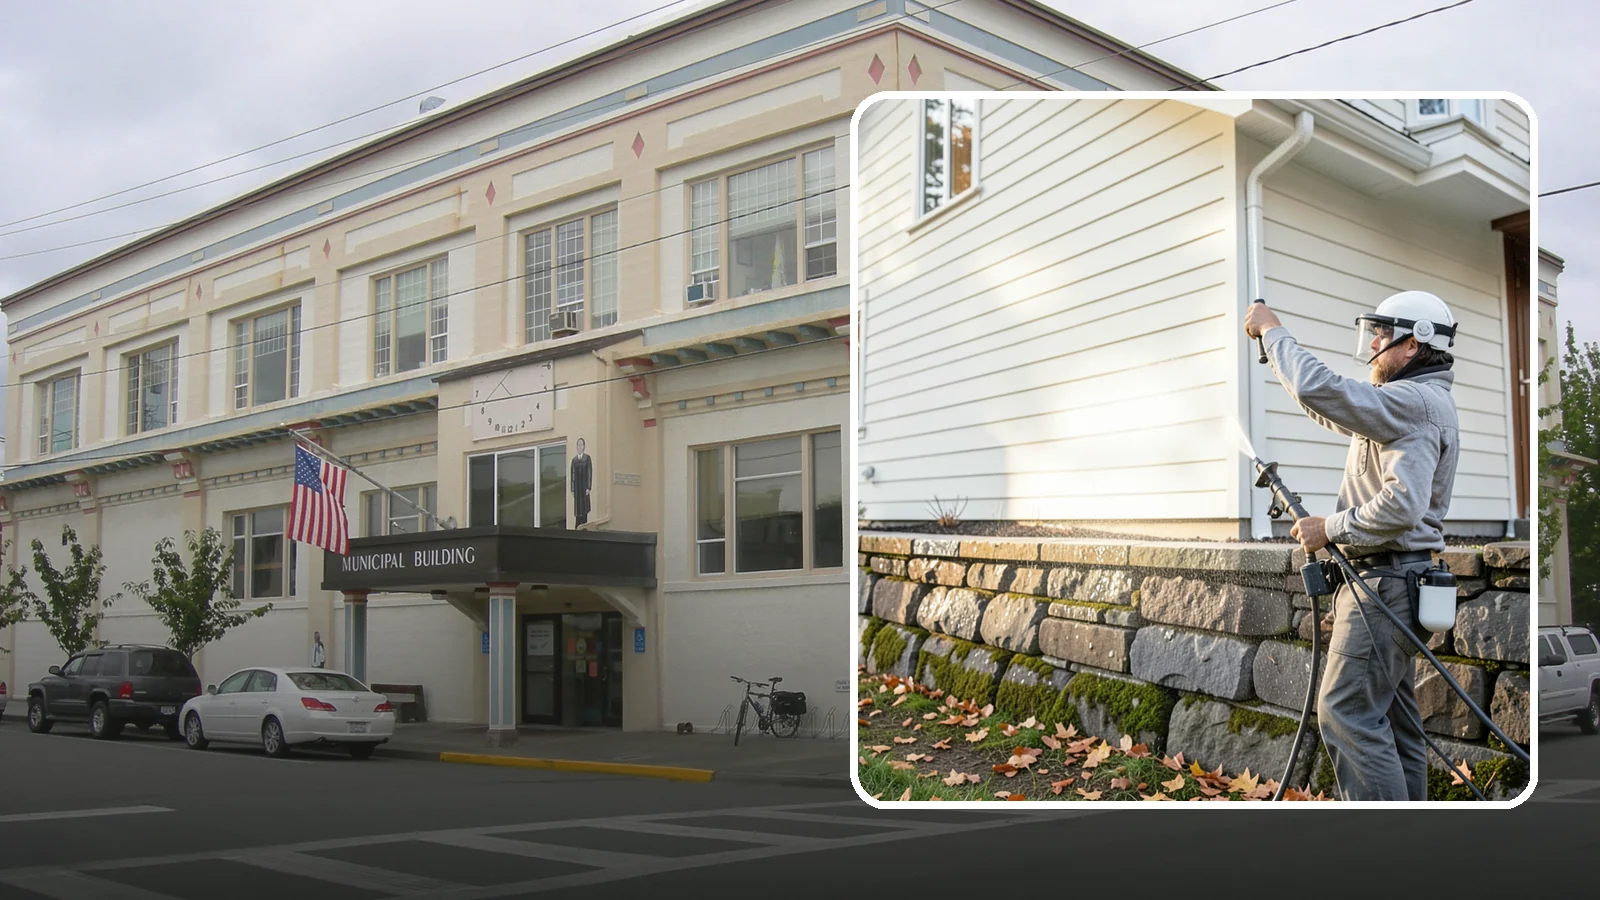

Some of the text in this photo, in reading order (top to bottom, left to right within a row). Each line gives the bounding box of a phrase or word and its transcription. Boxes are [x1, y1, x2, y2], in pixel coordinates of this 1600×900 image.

[480, 407, 485, 415] 8
[487, 417, 492, 426] 9
[529, 413, 533, 422] 3
[494, 424, 500, 432] 10
[521, 420, 525, 429] 2
[501, 425, 506, 433] 11
[507, 425, 513, 433] 12
[342, 546, 475, 571] MUNICIPAL BUILDING
